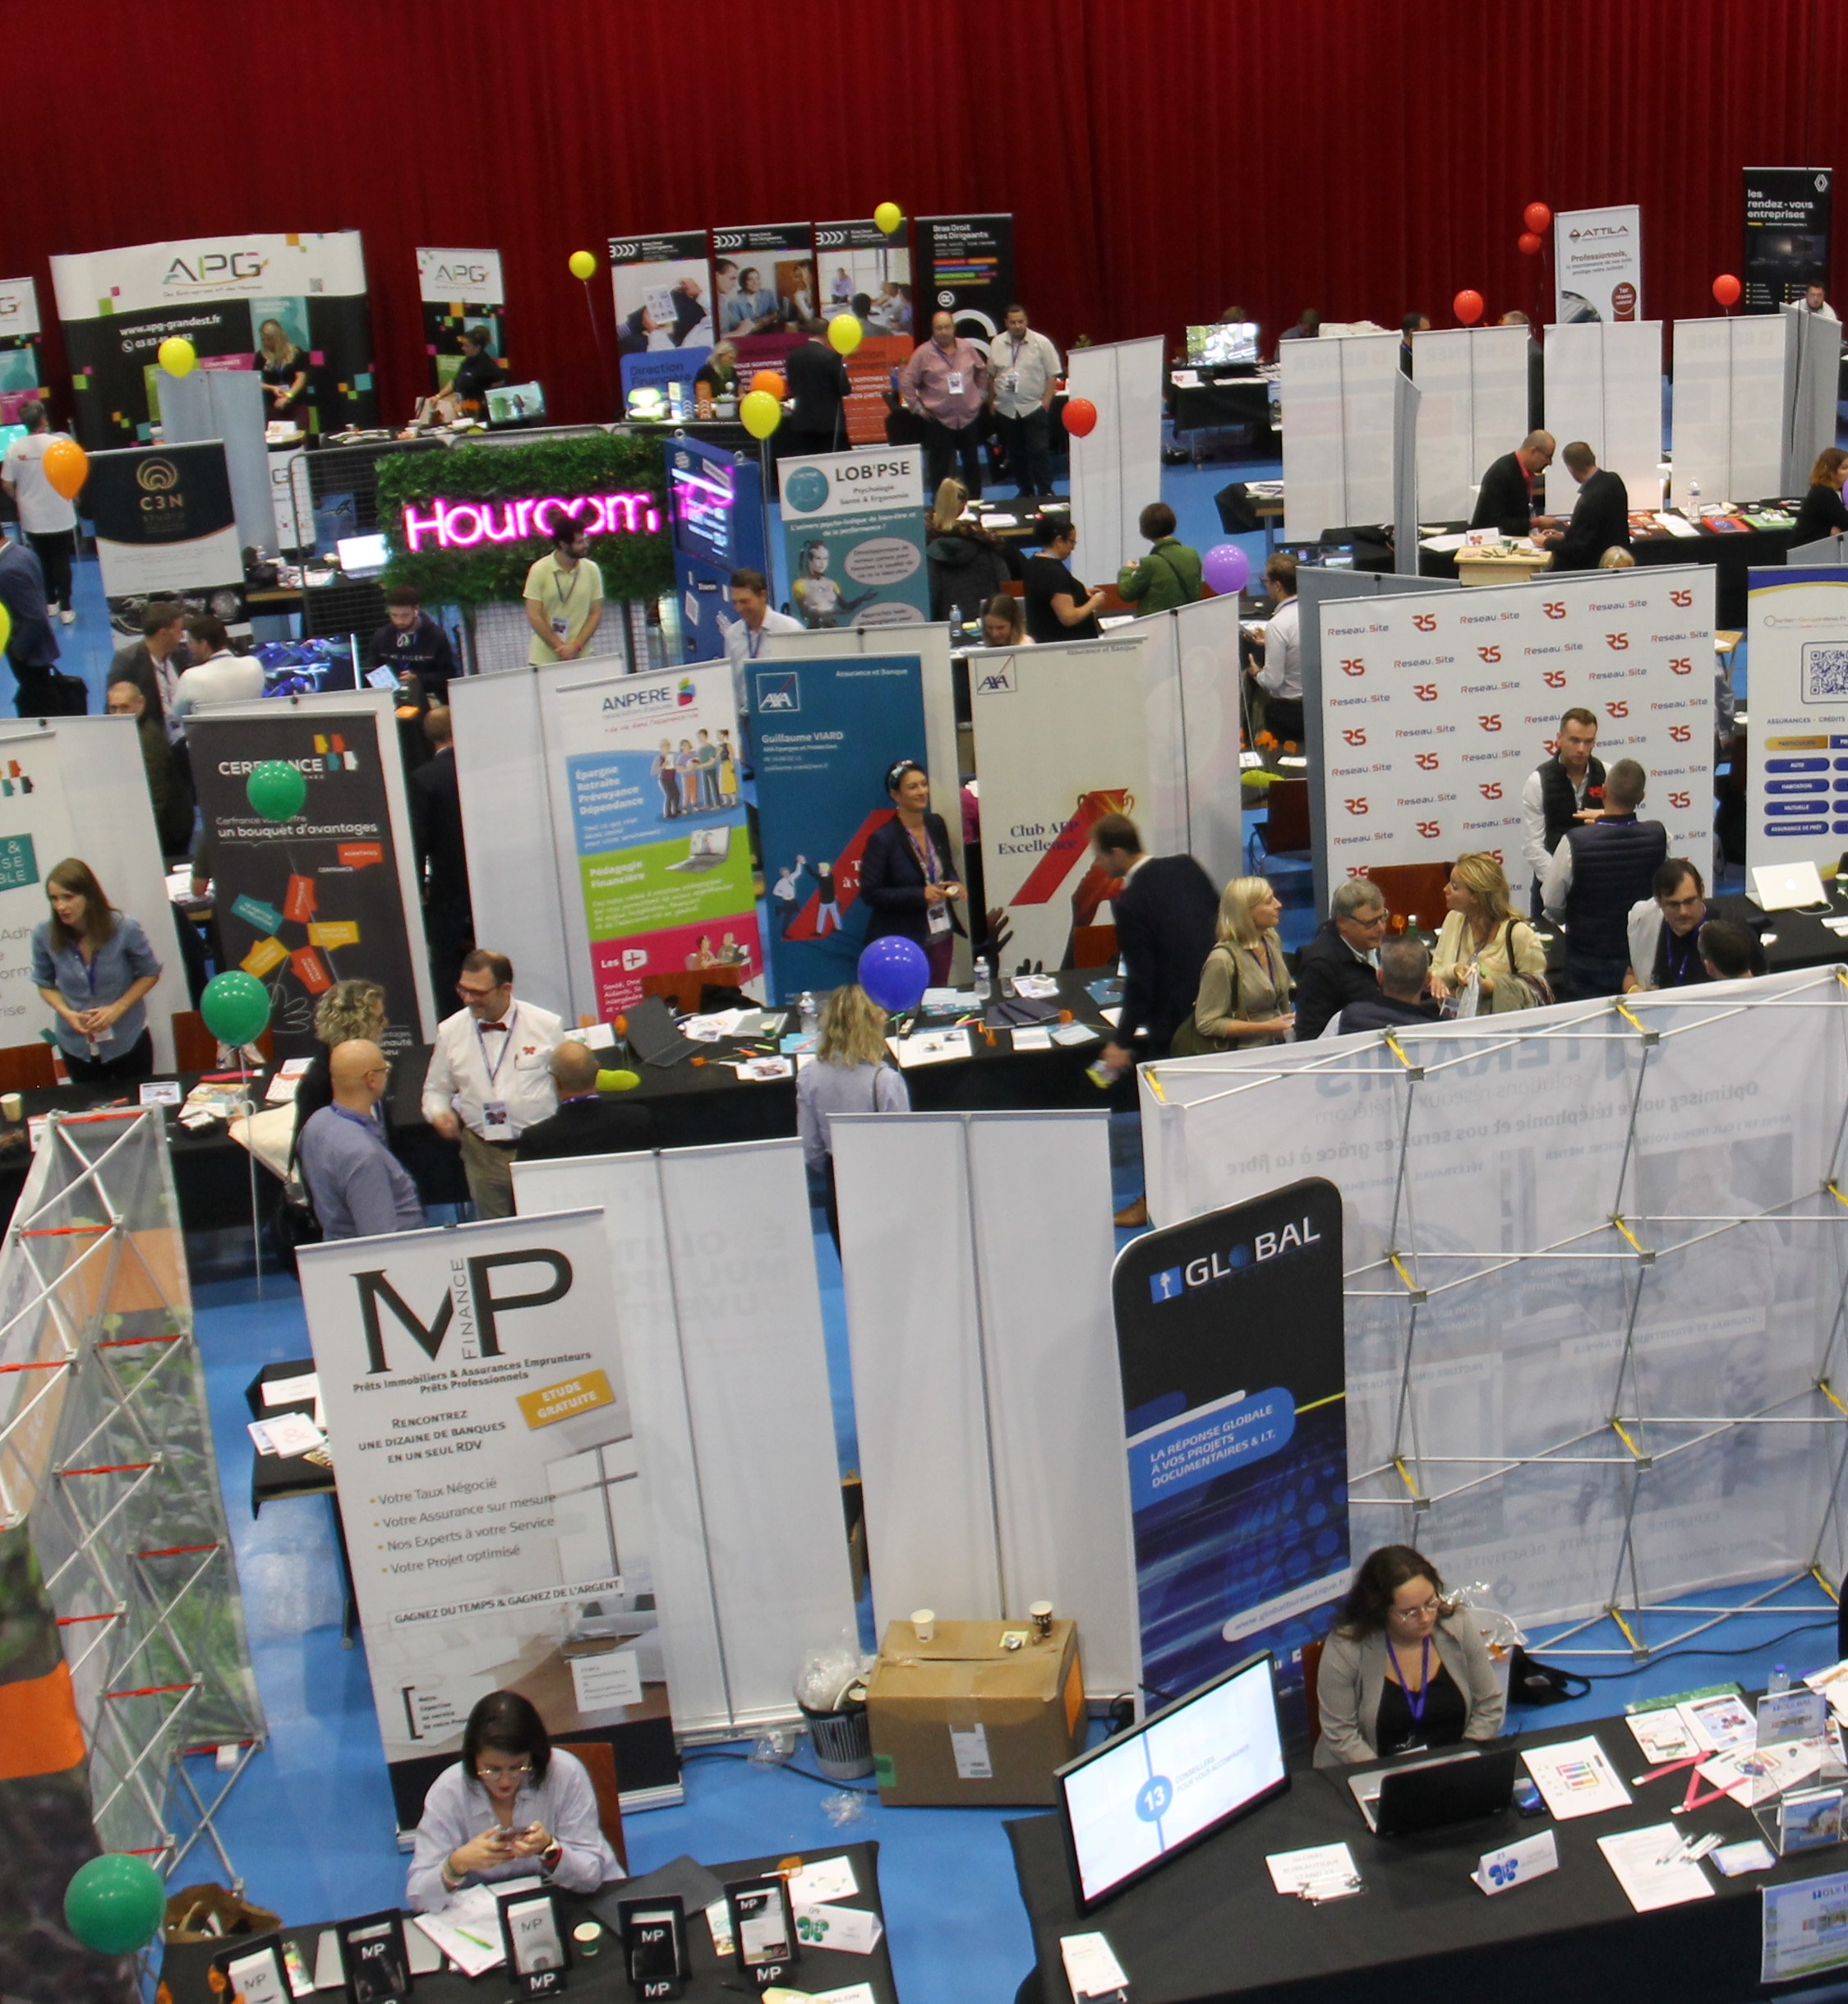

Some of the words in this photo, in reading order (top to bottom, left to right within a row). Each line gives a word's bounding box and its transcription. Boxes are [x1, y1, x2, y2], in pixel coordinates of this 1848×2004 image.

[1748, 189, 1763, 198] les
[1748, 210, 1805, 219] entreprises
[1583, 226, 1629, 237] ATTILA
[163, 252, 263, 284] APG
[435, 265, 486, 283] APG
[119, 314, 222, 336] www.apg-grandest.fr
[629, 362, 684, 375] Direction
[835, 461, 910, 481] LOB'PSE
[1588, 600, 1648, 612] Reseau.Site
[1460, 612, 1519, 624] Reseau.Site
[1328, 624, 1389, 637] Reseau.Site
[1652, 630, 1708, 643] Reseau.Site
[1524, 643, 1583, 656] Reseau.Site
[1394, 656, 1454, 668] Reseau.Site
[1588, 667, 1647, 680] Reseau.Site
[978, 674, 1009, 691] AXA
[1461, 681, 1520, 693] Reseau.Site
[602, 686, 672, 712] ANPERE
[759, 692, 793, 708] AXA
[1330, 694, 1390, 707] Reseau.Site
[1651, 698, 1707, 711] Reseau.Site
[762, 733, 813, 744] Guillaume
[813, 731, 844, 740] VIARD
[1395, 725, 1455, 738] Reseau.Site
[1462, 749, 1521, 762] Reseau.Site
[218, 758, 323, 776] CERFNCE
[1331, 762, 1392, 776] Reseau.Site
[1650, 765, 1707, 777] Reseau.Site
[577, 777, 621, 792] Retraite
[579, 797, 644, 815] Dépendance
[1397, 794, 1457, 806] Reseau.Site
[218, 827, 236, 837] un
[238, 824, 293, 839] bouquet
[296, 823, 378, 836] d'avantages
[1010, 823, 1044, 838] Club
[1463, 817, 1522, 830] Reseau.Site
[998, 838, 1079, 855] Excellence
[1334, 832, 1394, 845] Reseau.Site
[601, 960, 619, 969] Les
[449, 1257, 478, 1361] FINANCE
[353, 1382, 381, 1393] Prêts
[384, 1371, 448, 1389] Immobiliers
[450, 1369, 458, 1378] &
[460, 1361, 522, 1377] Assurances
[523, 1351, 592, 1370] Emprunteurs
[420, 1383, 449, 1394] Prêts
[450, 1370, 529, 1389] Professionnels
[541, 1381, 583, 1403] ETUDE
[537, 1390, 598, 1419] GRATUITE
[385, 1432, 431, 1448] DIZAINE
[433, 1428, 449, 1440] DE
[450, 1421, 507, 1437] BANQUES
[1150, 1449, 1165, 1463] LA
[1167, 1424, 1220, 1455] RÉPONSE
[1222, 1403, 1274, 1433] GLOBALE
[387, 1453, 403, 1464] EN
[405, 1450, 423, 1461] UN
[424, 1445, 454, 1458] SEUL
[456, 1440, 483, 1453] RDV
[1162, 1453, 1186, 1470] VOS
[1187, 1433, 1235, 1459] PROJETS
[1152, 1440, 1249, 1488] DOCUMENTAIRES
[1251, 1437, 1259, 1447] &
[378, 1490, 412, 1505] Votre
[413, 1486, 445, 1500] Taux
[446, 1477, 498, 1495] Négocié
[382, 1513, 417, 1528] Votre
[419, 1504, 485, 1523] Assurance
[486, 1501, 508, 1513] sur
[509, 1493, 557, 1509] mesure
[387, 1538, 412, 1551] Nos
[414, 1530, 463, 1550] Experts
[464, 1528, 473, 1539] à
[474, 1523, 508, 1537] votre
[509, 1516, 555, 1533] Service
[390, 1559, 425, 1574] Votre
[426, 1552, 464, 1570] Projet
[466, 1545, 521, 1564] optimisé
[394, 1609, 439, 1624] GAGNEZ
[440, 1605, 457, 1616] DU
[458, 1601, 495, 1614] TEMPS
[507, 1592, 551, 1606] GAGNEZ
[552, 1588, 568, 1598] DE
[569, 1579, 620, 1596] L'ARGENT
[1143, 1784, 1166, 1812] 13
[740, 1898, 758, 1910] MP
[641, 1928, 666, 1943] MP
[360, 1942, 386, 1960] MP
[530, 1972, 555, 1990] MP
[755, 1965, 782, 1982] MP
[644, 1982, 671, 1997] MP
